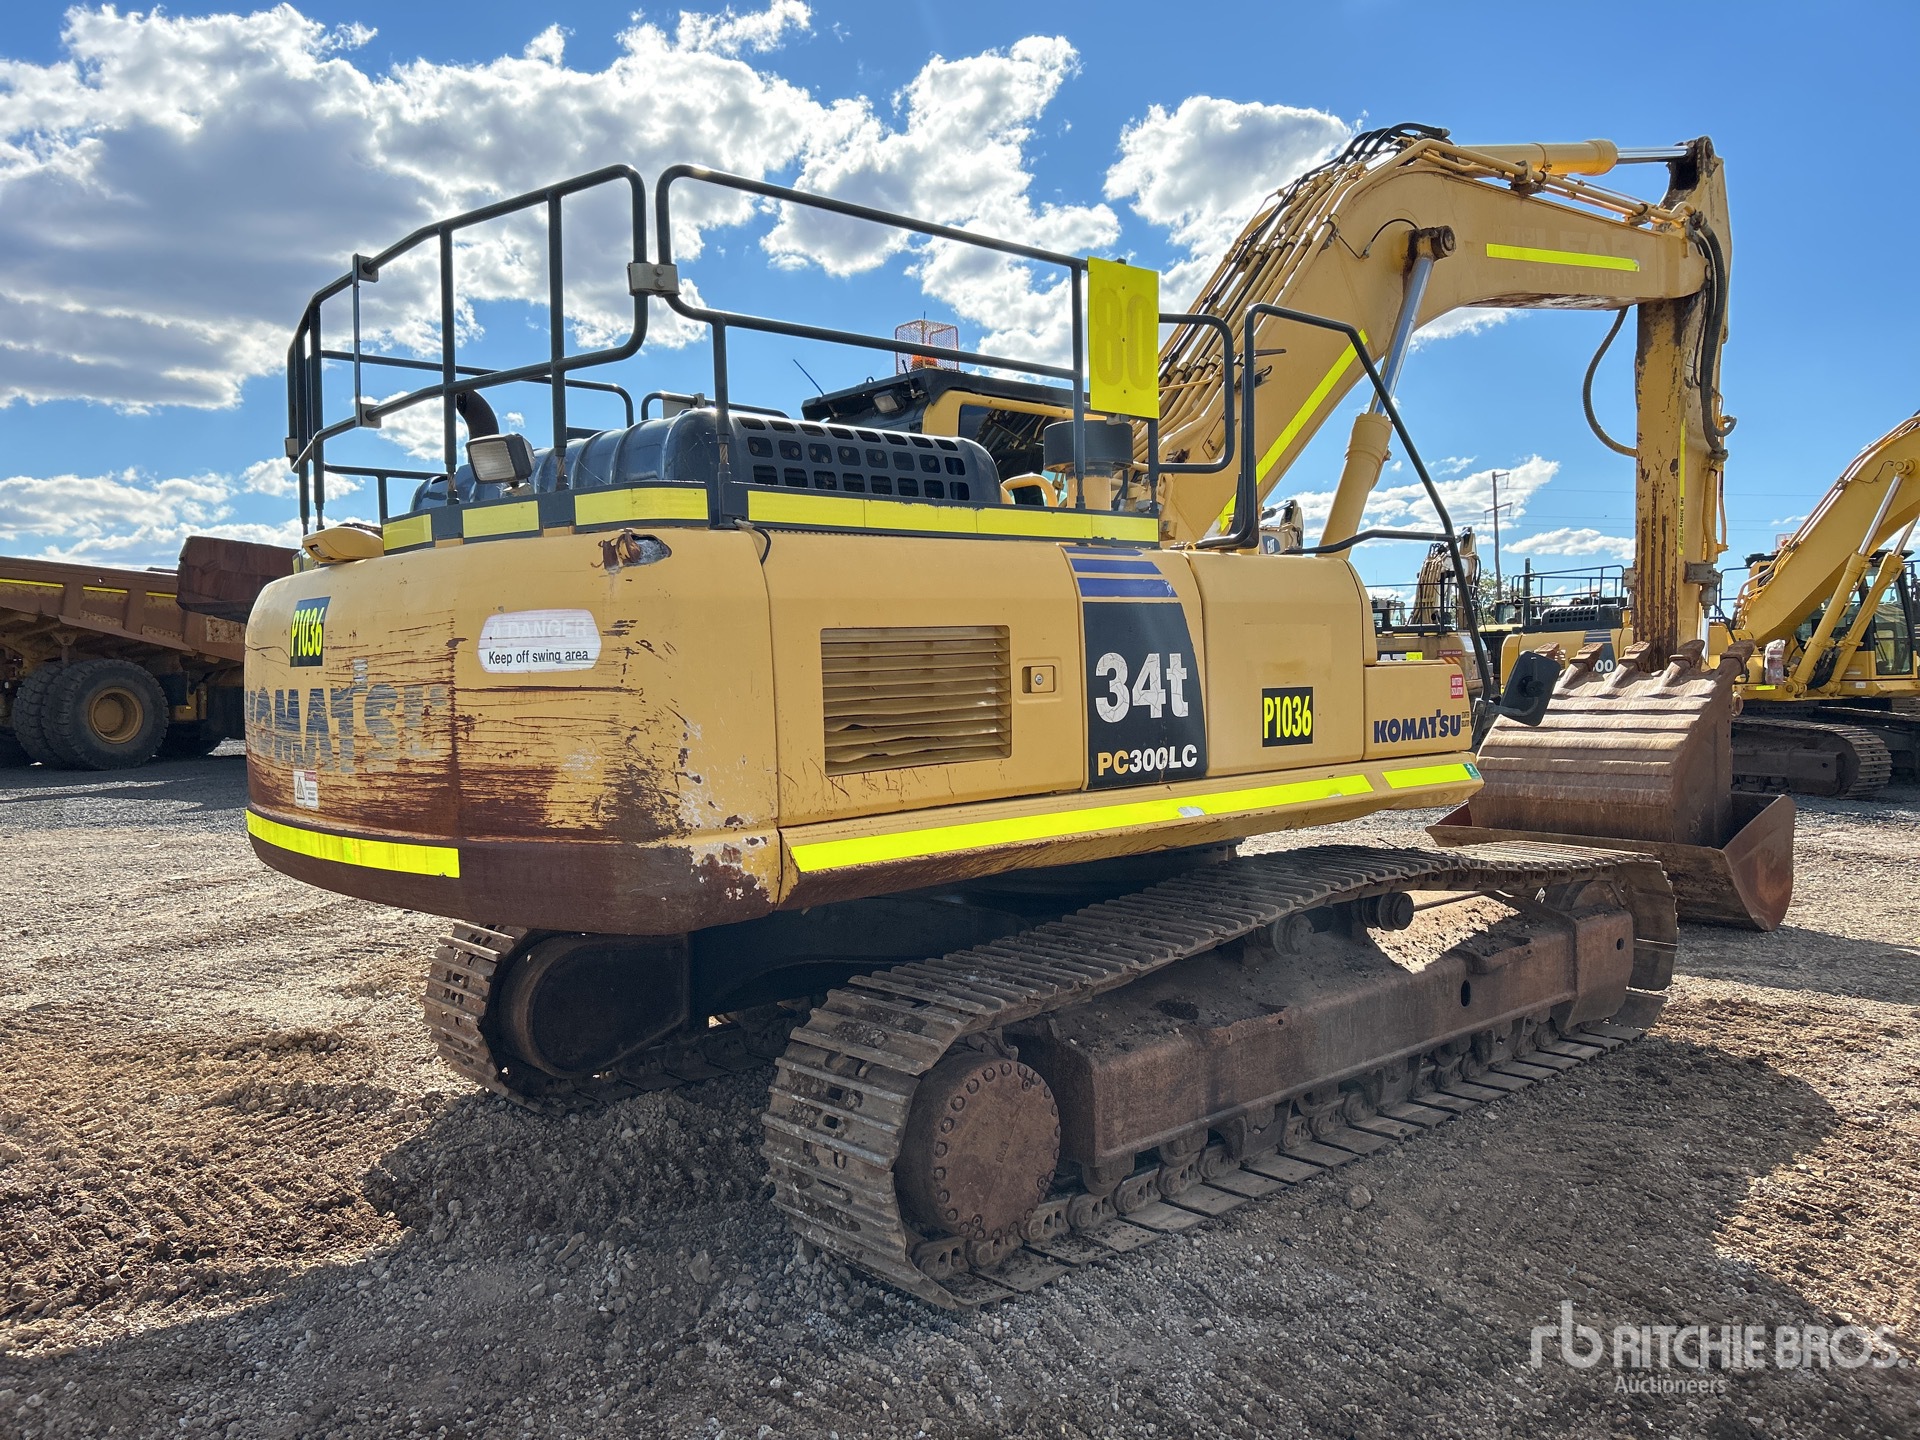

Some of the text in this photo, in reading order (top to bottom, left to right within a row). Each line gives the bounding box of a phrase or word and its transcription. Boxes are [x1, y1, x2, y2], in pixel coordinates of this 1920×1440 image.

[1095, 287, 1154, 391] 80
[291, 607, 325, 656] P1036
[507, 619, 588, 639] DANGER
[488, 649, 589, 666] Keep off swing area
[1593, 659, 1614, 672] 00
[1095, 652, 1188, 723] 34t
[1264, 695, 1312, 739] P1036
[1374, 709, 1461, 743] KOMATSU
[1097, 744, 1198, 776] PC300LC
